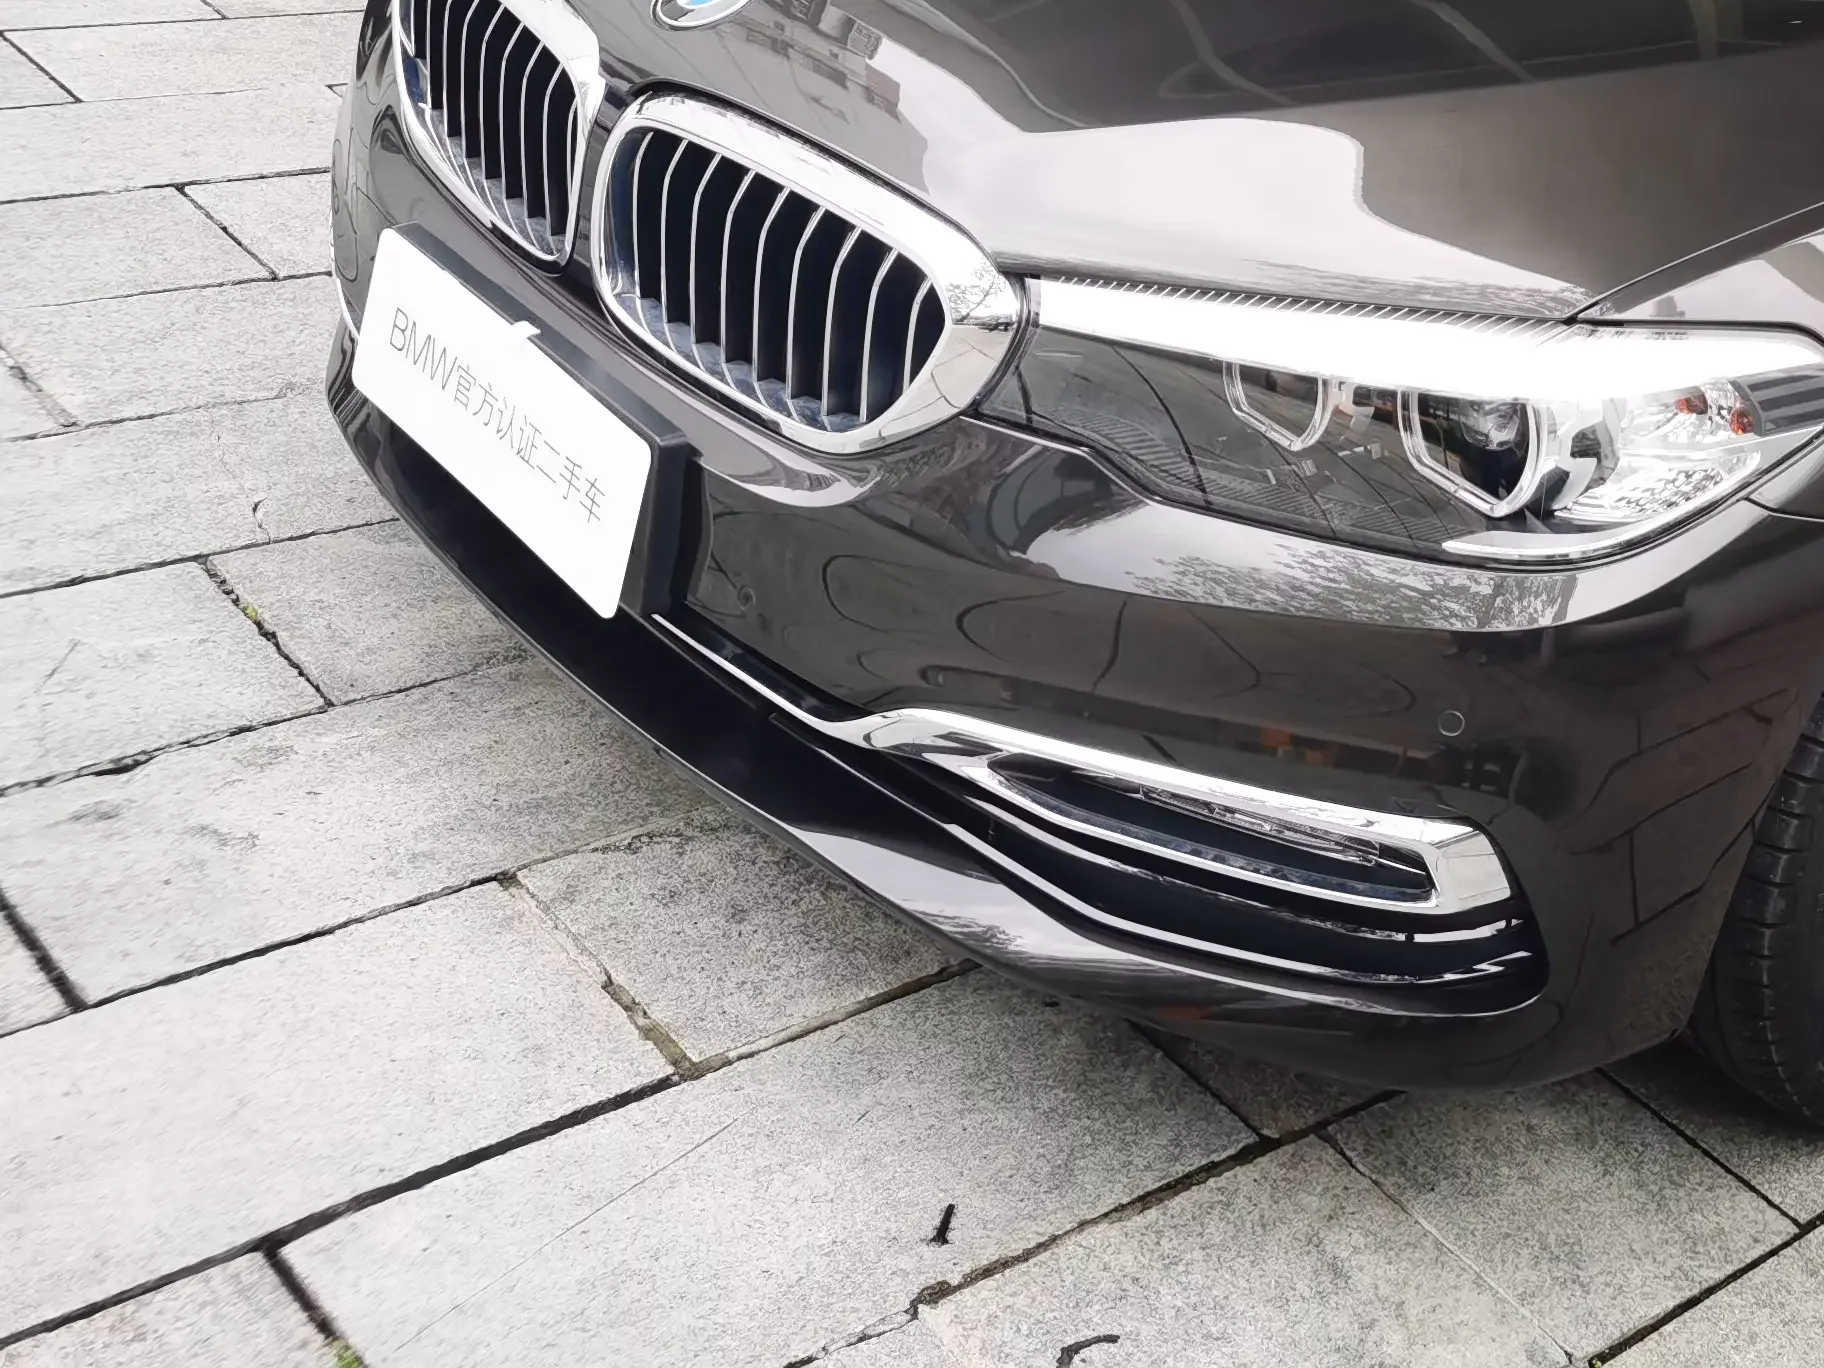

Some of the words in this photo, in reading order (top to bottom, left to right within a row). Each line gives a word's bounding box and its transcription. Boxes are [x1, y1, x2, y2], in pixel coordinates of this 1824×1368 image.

[389, 307, 605, 524] BMW官方认证二手车
